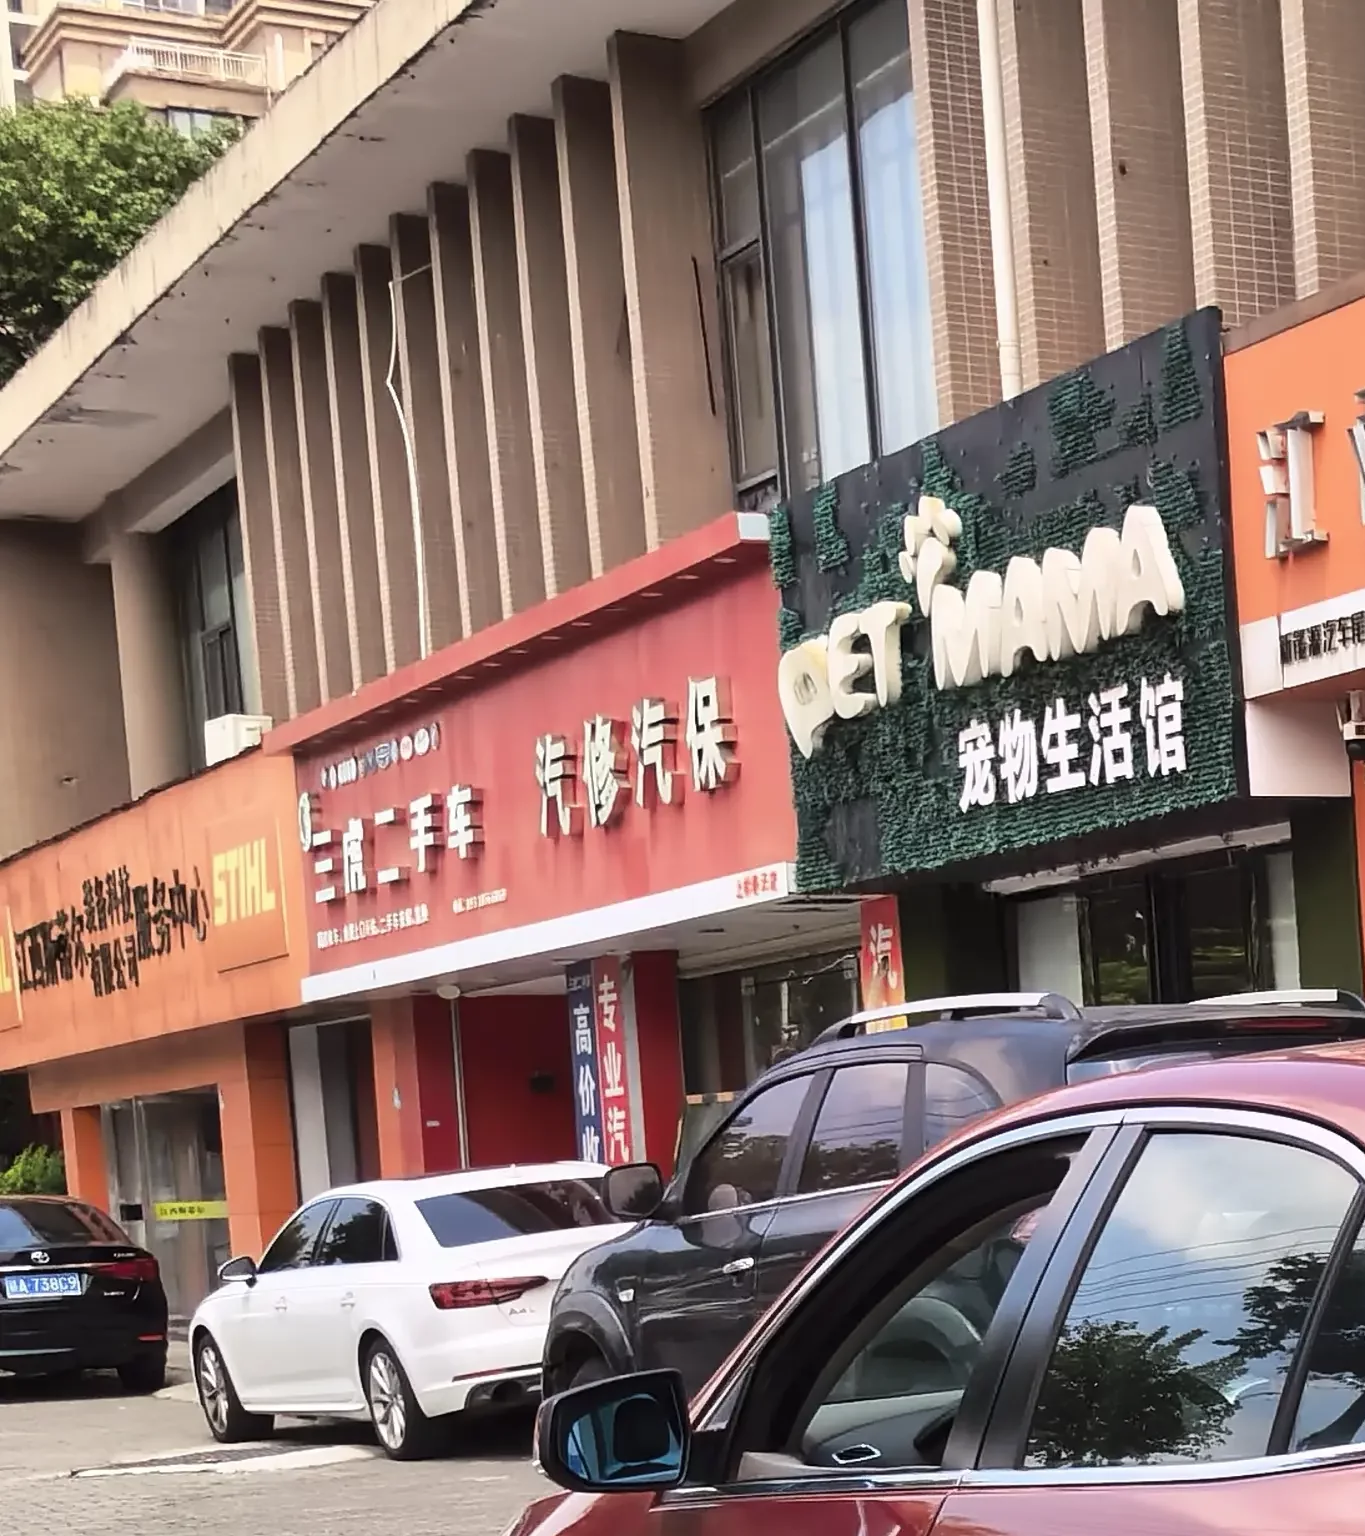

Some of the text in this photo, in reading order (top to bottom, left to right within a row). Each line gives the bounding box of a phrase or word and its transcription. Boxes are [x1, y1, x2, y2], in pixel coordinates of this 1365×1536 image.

[776, 505, 1186, 758] PET MAMA
[534, 675, 740, 836] 汽修汽保
[958, 673, 1187, 813] 宠物生活馆
[212, 837, 276, 927] STIHL
